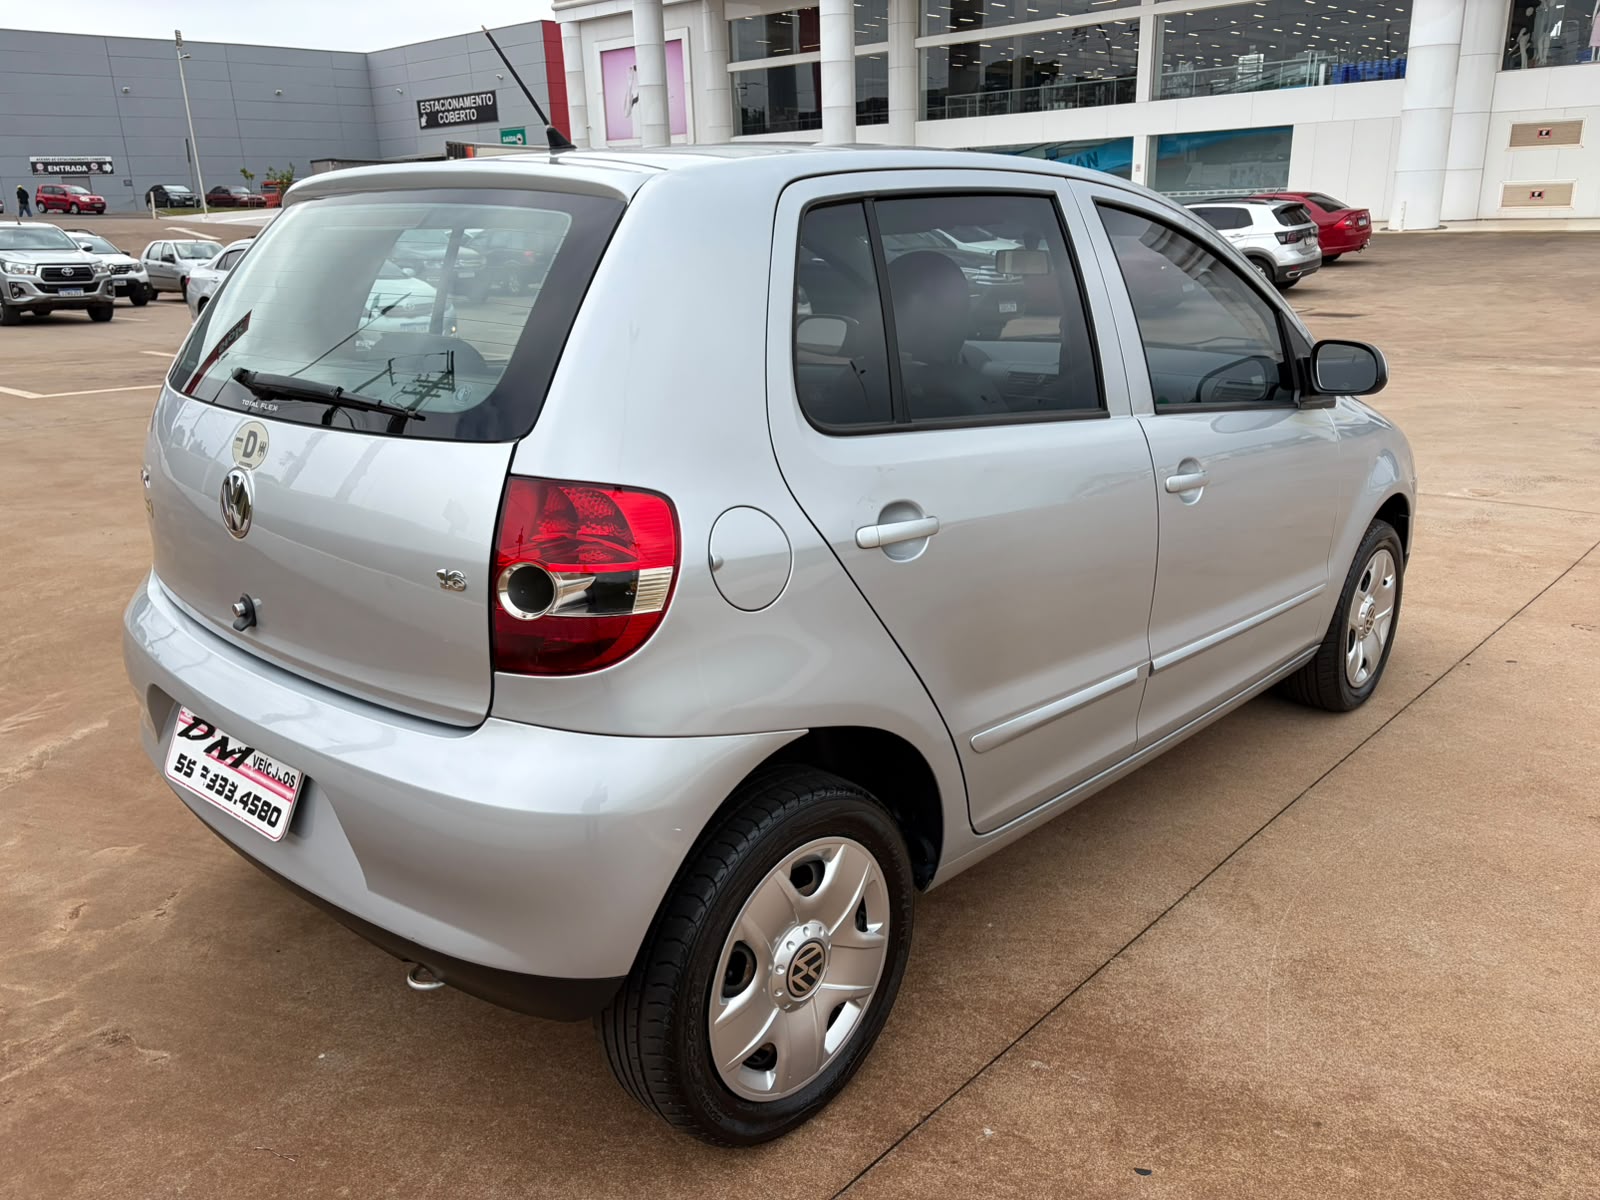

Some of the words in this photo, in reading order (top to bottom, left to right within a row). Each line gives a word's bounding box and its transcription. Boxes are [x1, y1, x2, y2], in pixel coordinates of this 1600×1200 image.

[420, 93, 493, 113] ESTACIONAMENTO
[437, 109, 477, 123] COBERTO
[47, 164, 88, 172] ENTRADA
[241, 399, 259, 409] TOTAL
[260, 402, 279, 411] FLEX
[242, 430, 258, 458] D
[177, 715, 255, 769] DM
[174, 753, 197, 778] 55
